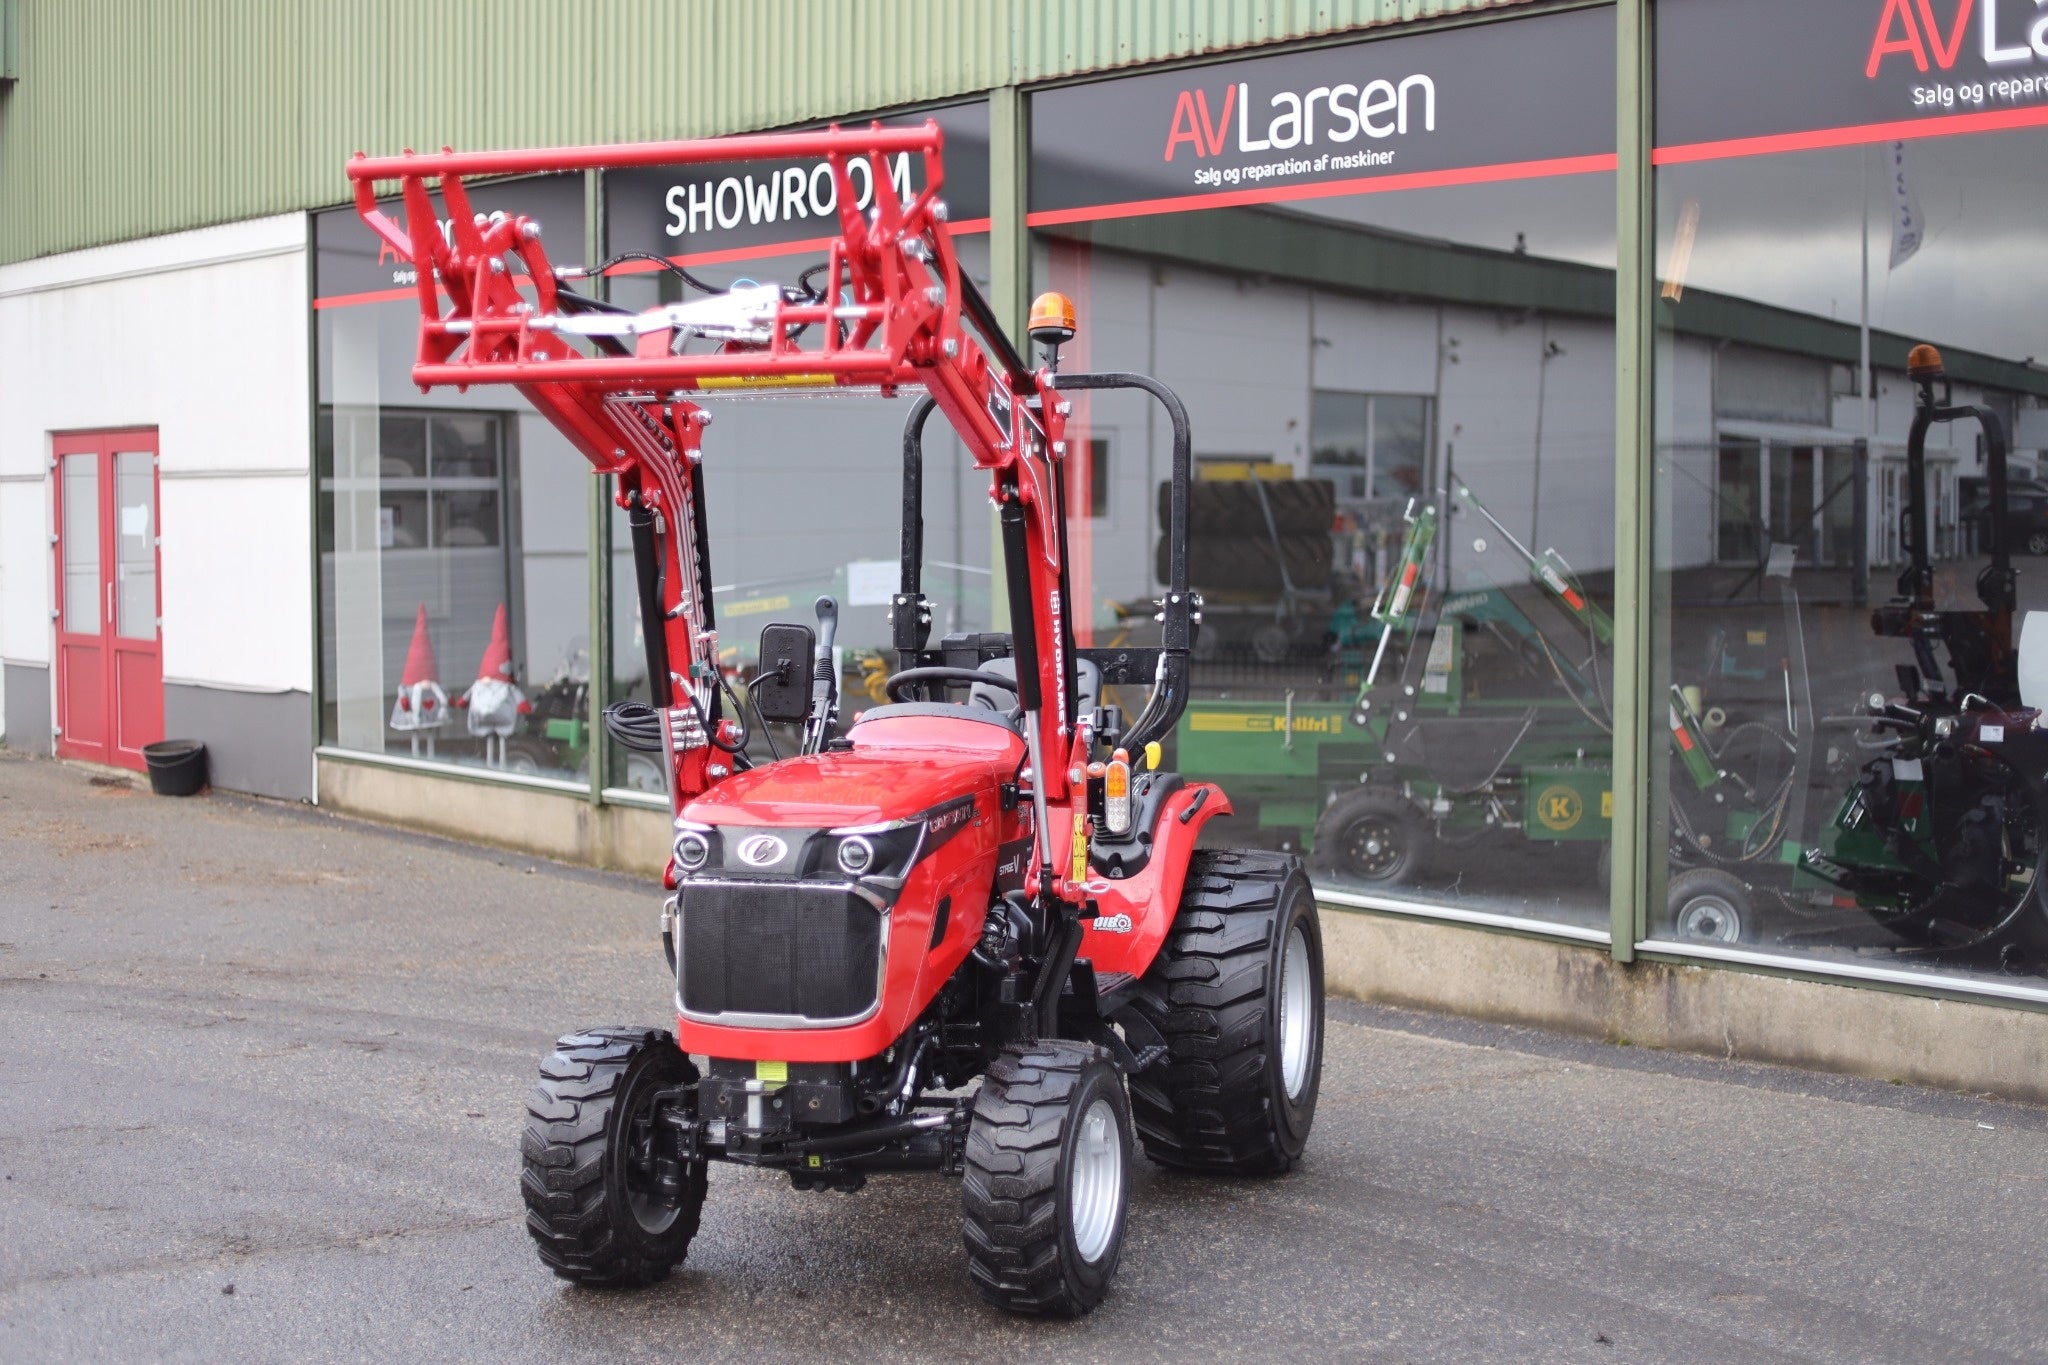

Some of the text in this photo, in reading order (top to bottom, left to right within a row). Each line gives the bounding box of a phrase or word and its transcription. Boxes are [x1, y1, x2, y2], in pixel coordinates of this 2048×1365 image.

[1164, 73, 1435, 162] AVLarsen
[1913, 84, 1954, 107] Salg
[1959, 83, 1984, 104] og
[665, 151, 912, 237] SHOWROOM
[1194, 150, 1396, 187] Salg og reparation af maskiner
